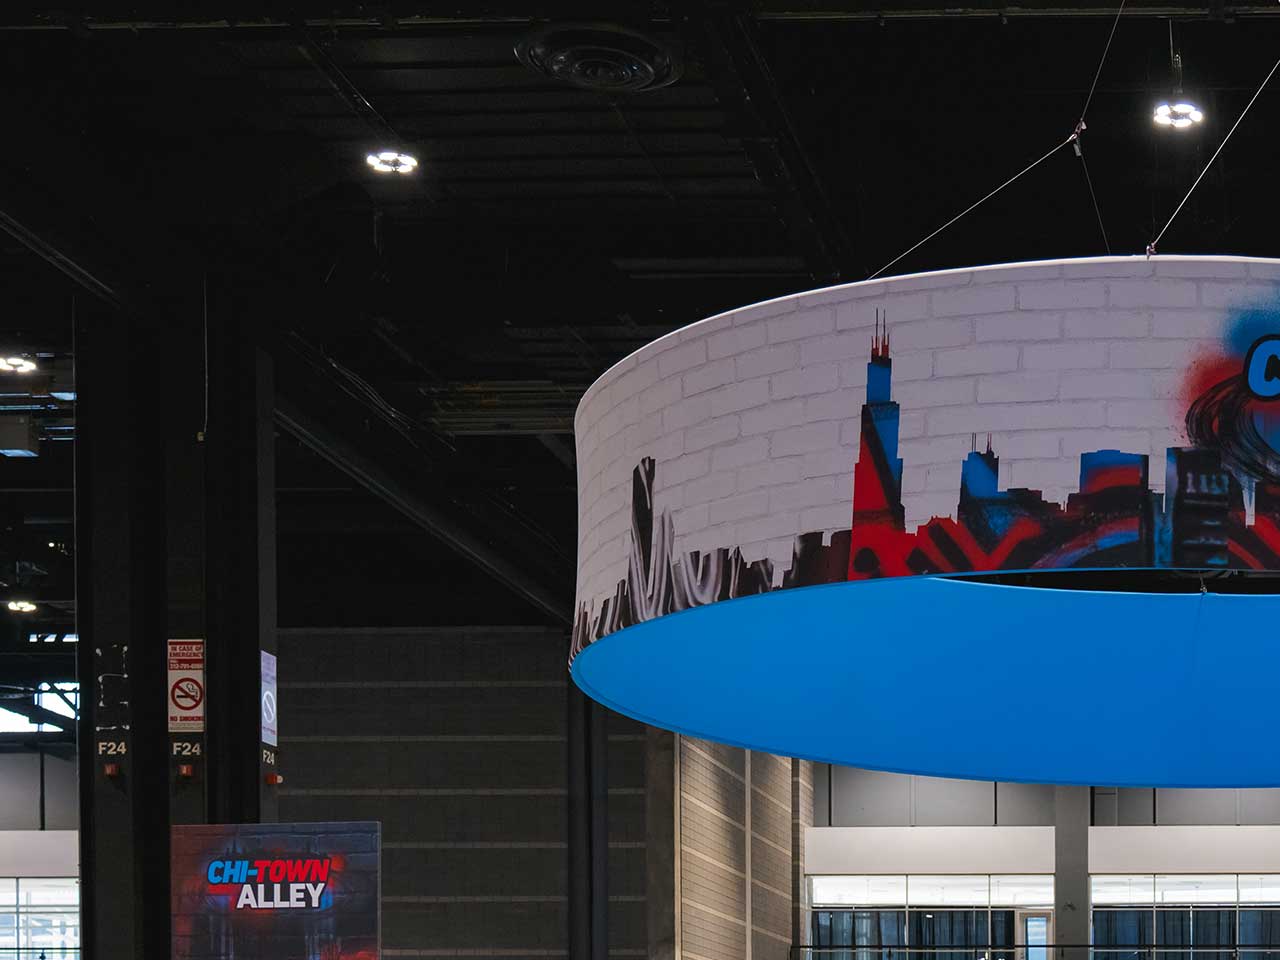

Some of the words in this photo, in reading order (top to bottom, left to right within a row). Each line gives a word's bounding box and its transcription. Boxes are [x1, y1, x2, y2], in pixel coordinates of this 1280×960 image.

[98, 742, 127, 755] F24
[172, 742, 201, 756] F24
[262, 750, 275, 765] F24
[208, 859, 330, 884] CHI-TOWN
[236, 883, 325, 909] ALLEY
